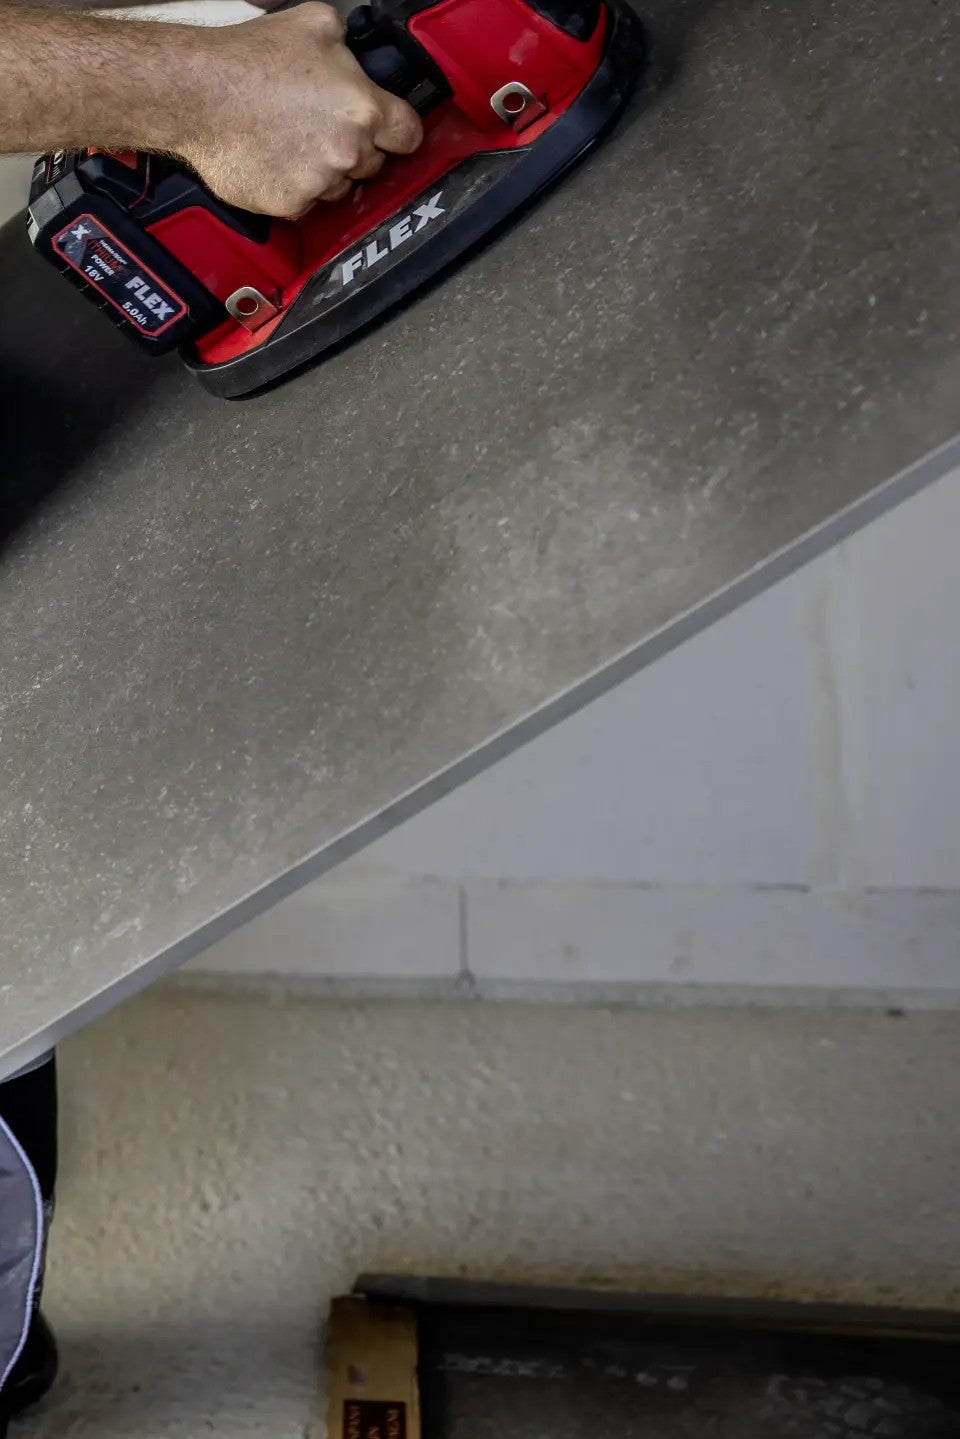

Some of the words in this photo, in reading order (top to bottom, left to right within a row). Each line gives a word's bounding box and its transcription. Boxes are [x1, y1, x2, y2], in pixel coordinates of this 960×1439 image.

[342, 191, 445, 285] FLEX
[85, 265, 104, 281] 18V
[91, 254, 115, 276] POWER
[125, 276, 175, 320] FLEX
[122, 301, 147, 325] 5.0Ah
